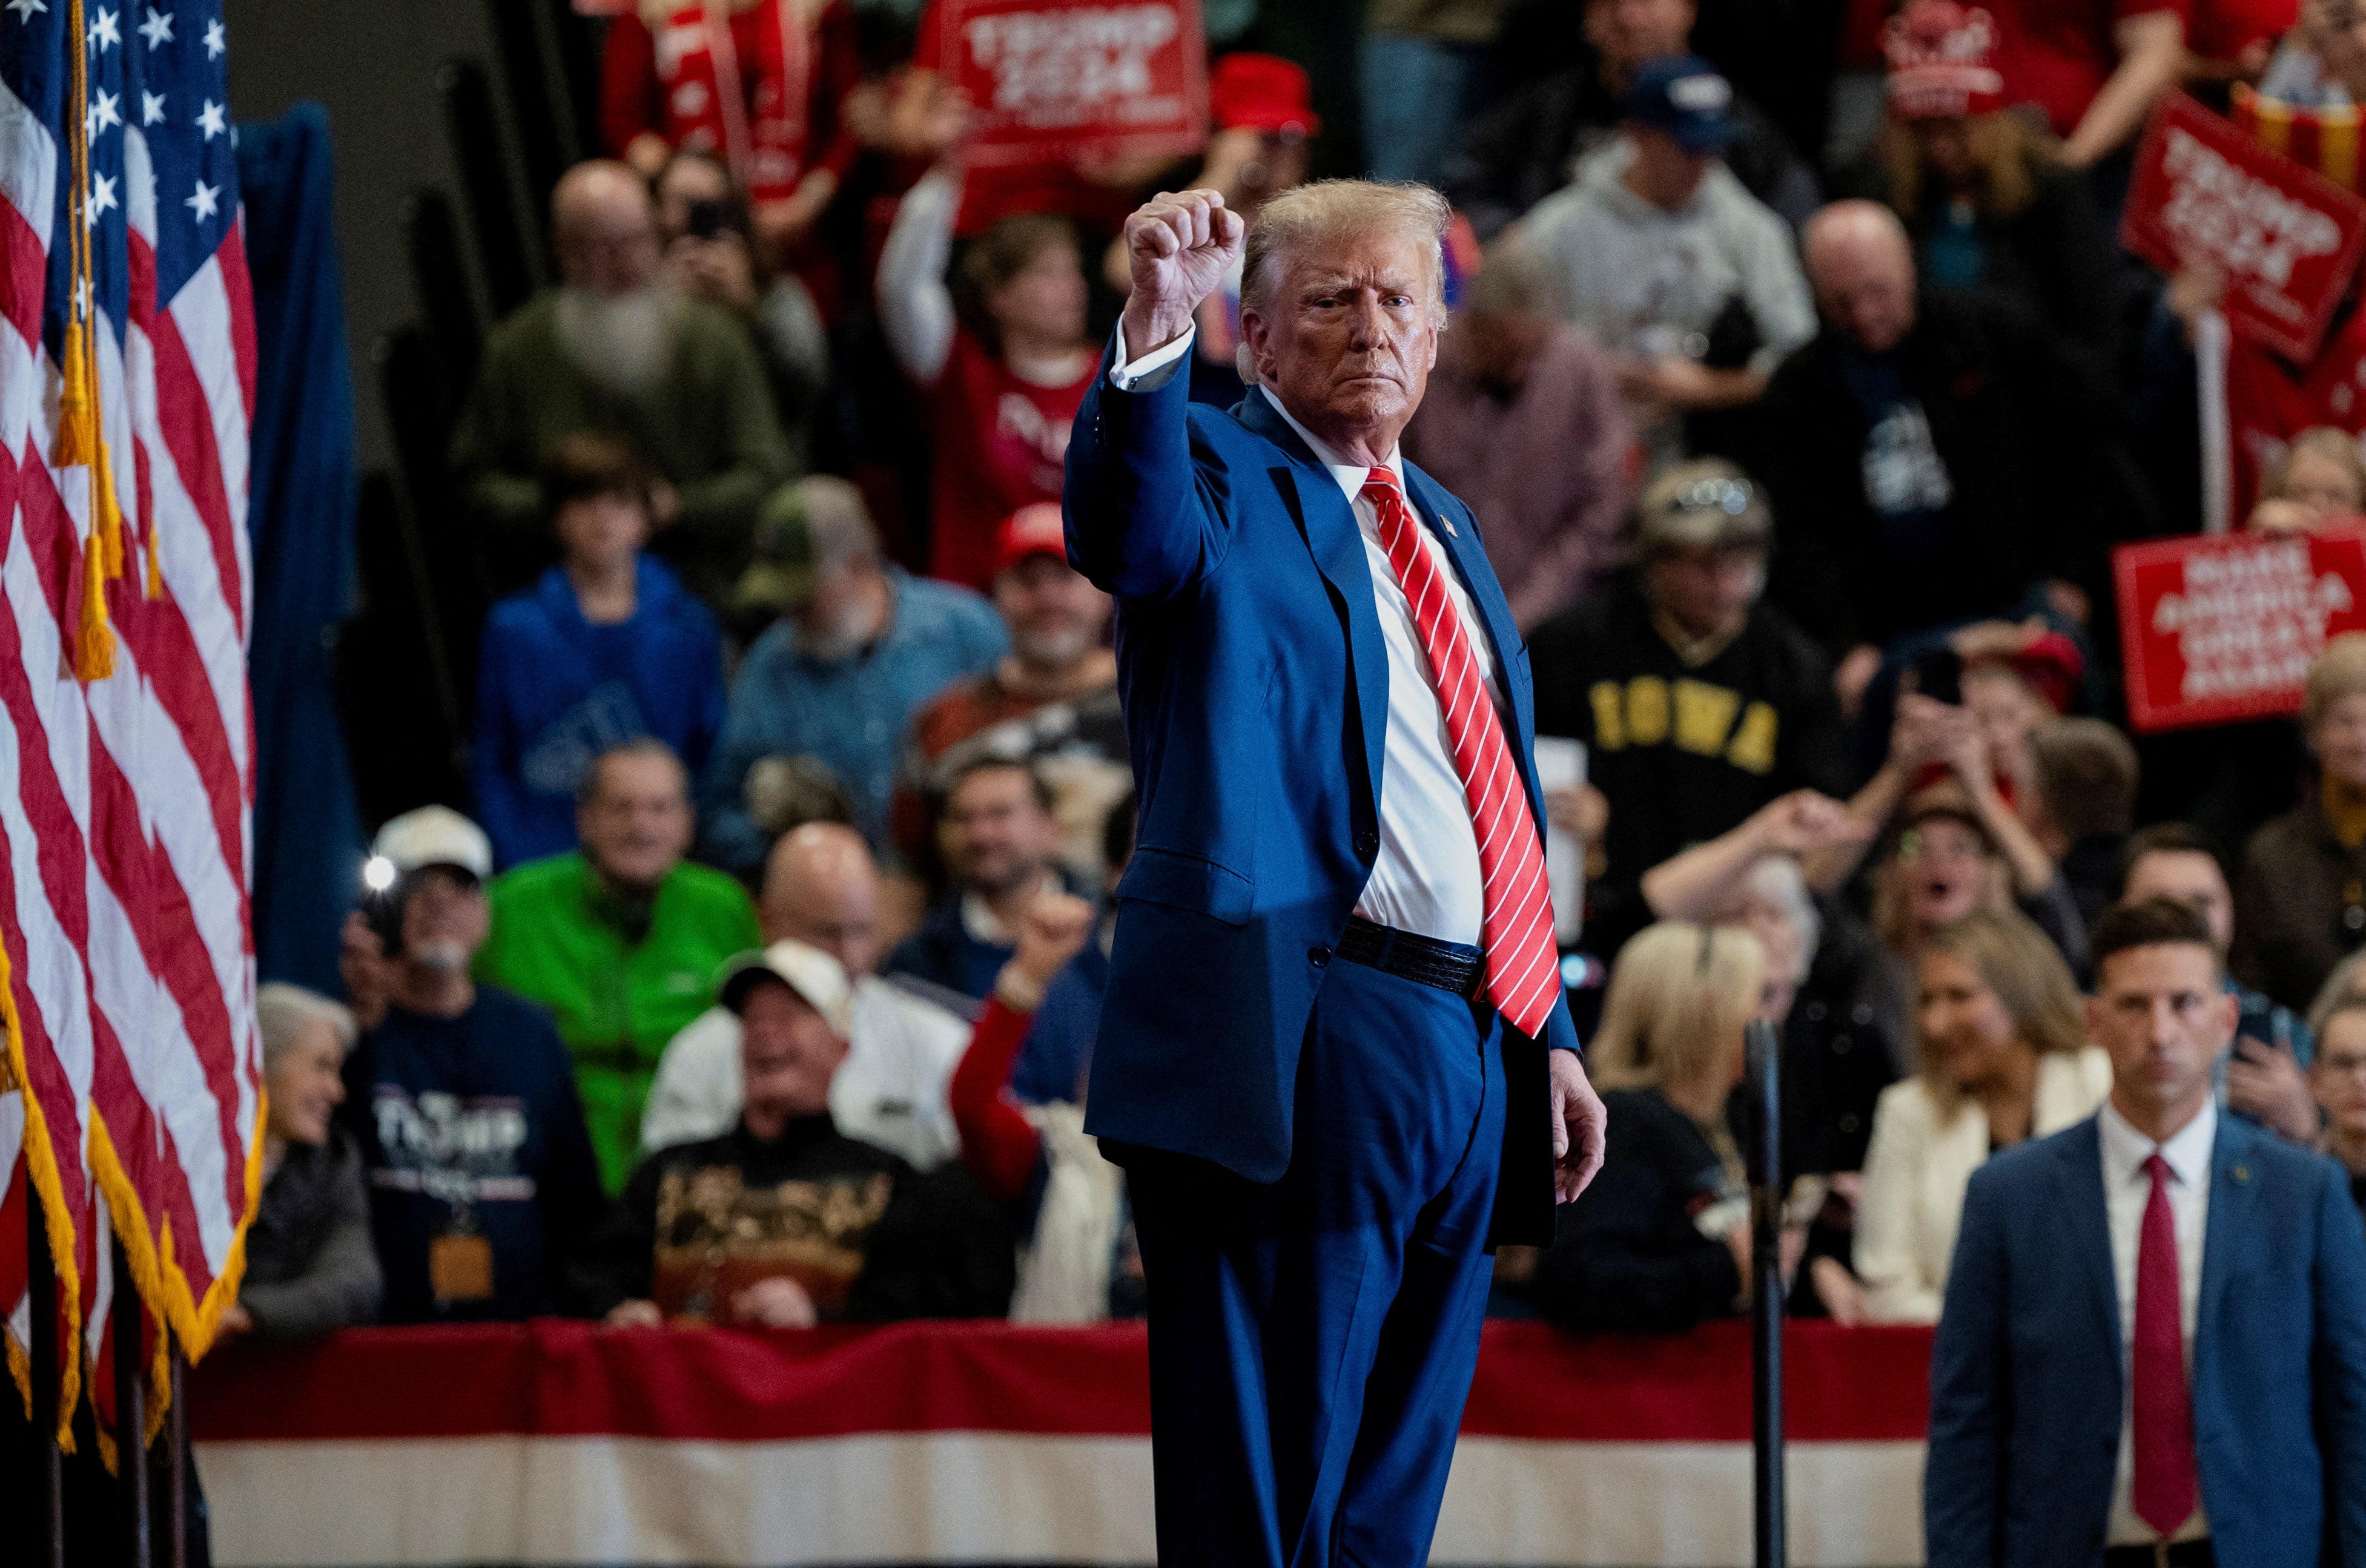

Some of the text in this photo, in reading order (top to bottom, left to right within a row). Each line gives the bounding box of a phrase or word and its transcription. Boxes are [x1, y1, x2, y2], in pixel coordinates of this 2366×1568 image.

[967, 8, 1172, 64] TRUMP
[996, 48, 1147, 105] 2024
[2167, 130, 2339, 254] TRUMP
[2165, 184, 2294, 285] 2024
[2185, 539, 2310, 587] MAKE
[2154, 574, 2351, 633] AMERICA
[2182, 609, 2325, 660] GREAT
[1588, 675, 1779, 776] IOWA
